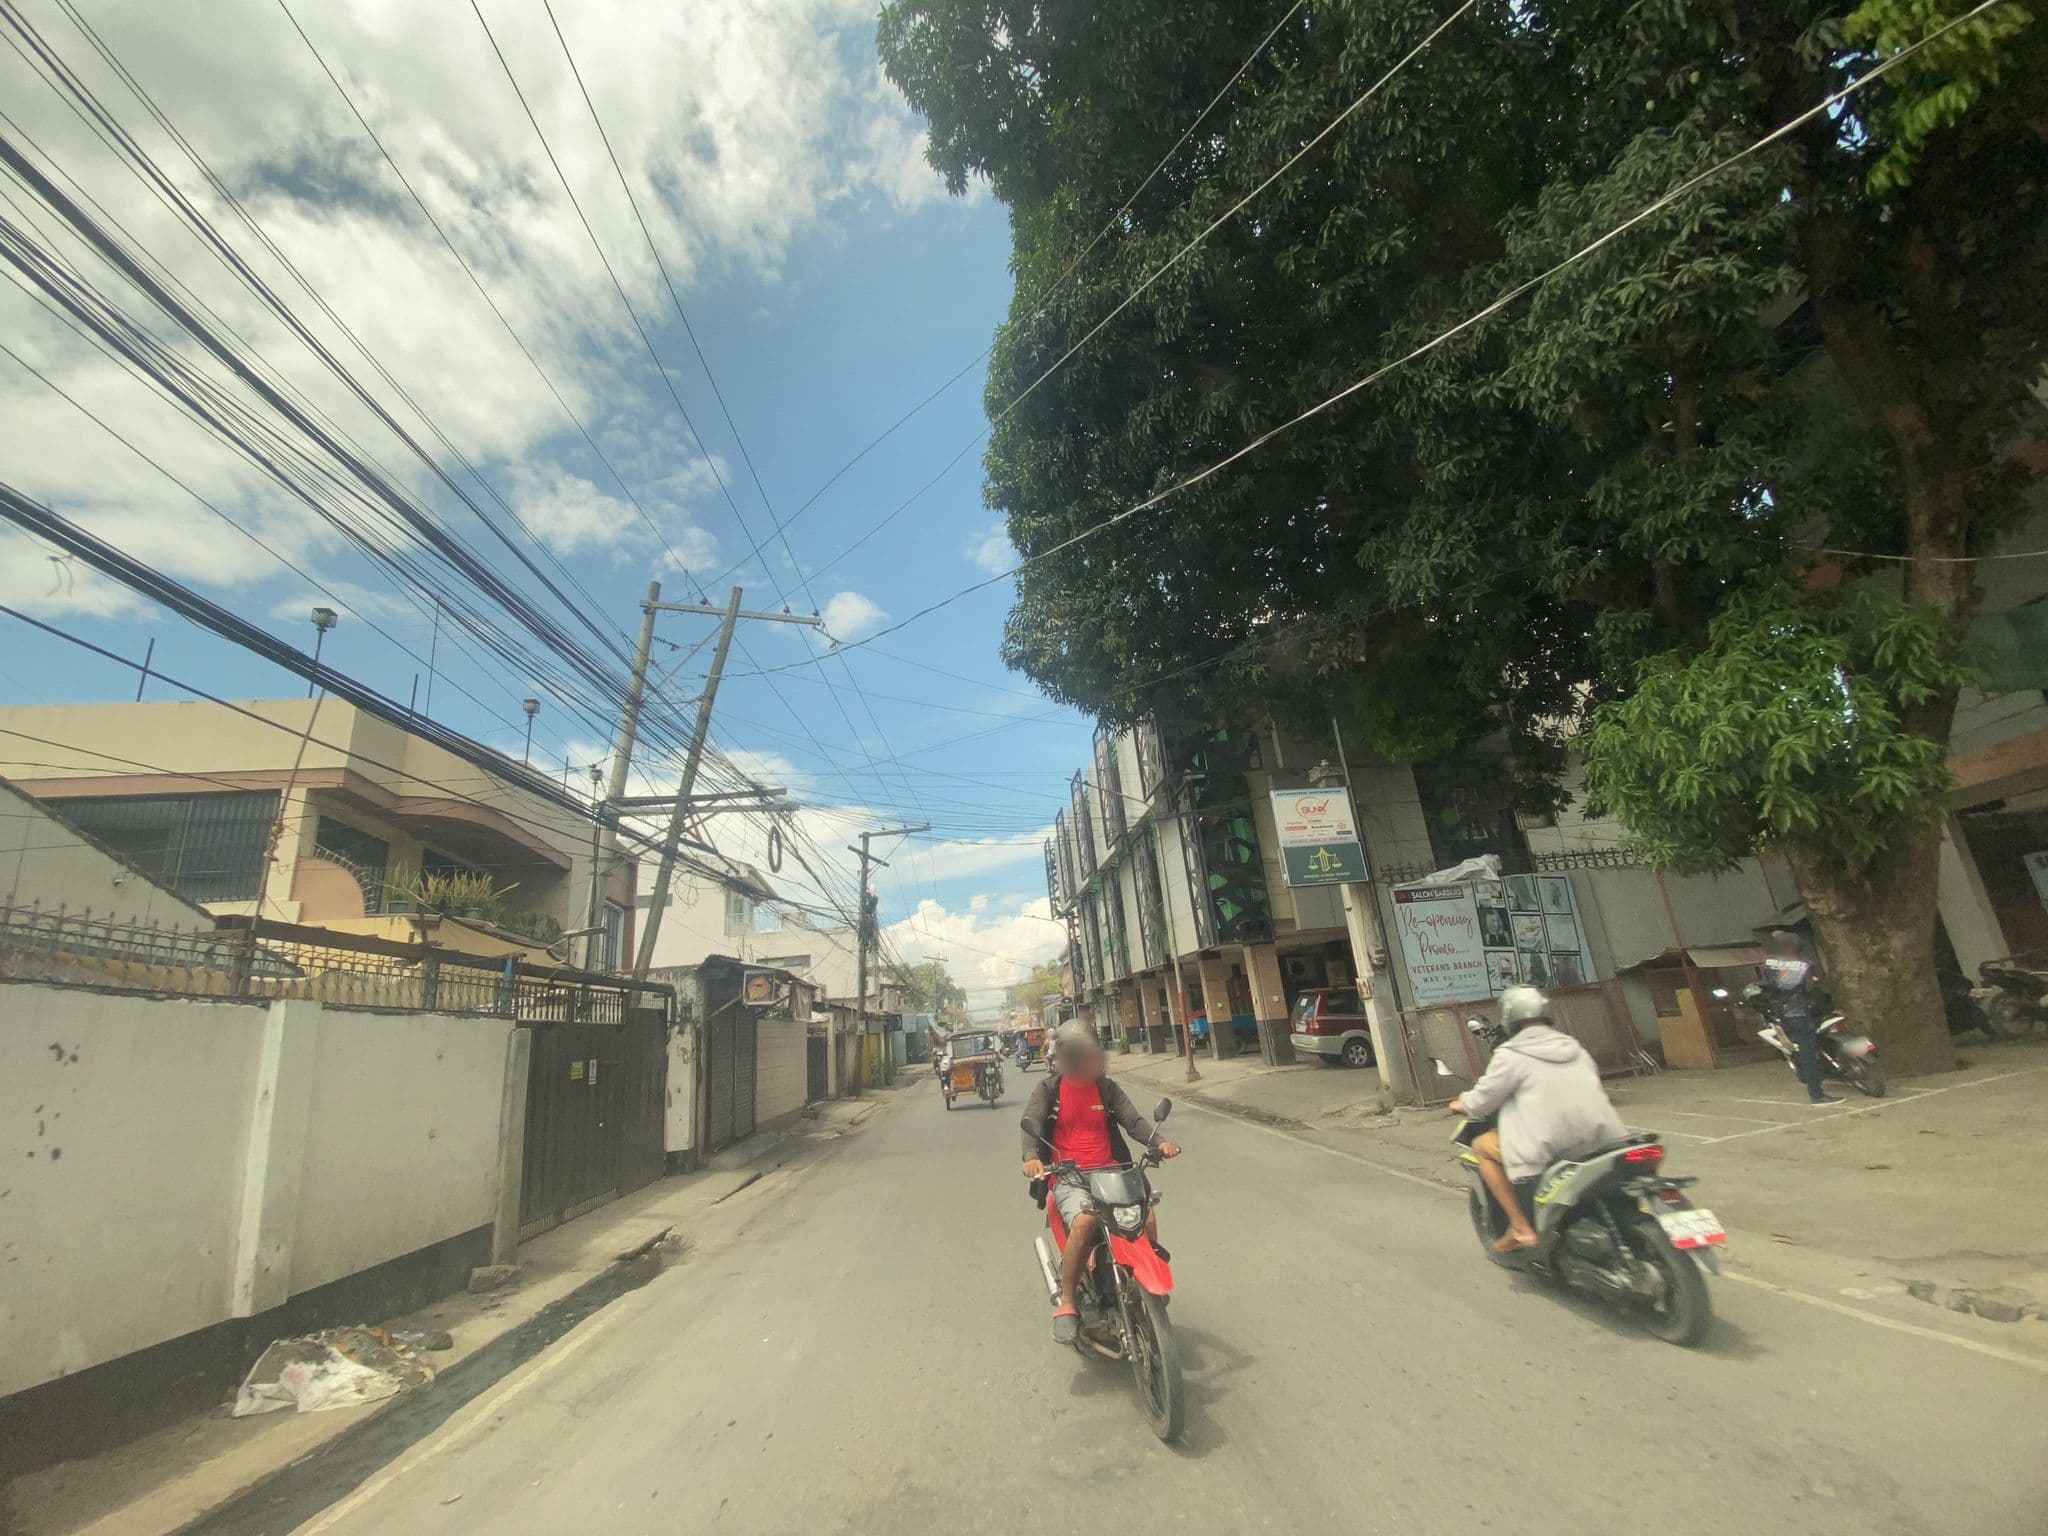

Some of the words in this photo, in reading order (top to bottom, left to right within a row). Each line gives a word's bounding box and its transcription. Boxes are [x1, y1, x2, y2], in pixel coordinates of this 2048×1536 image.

[1410, 889, 1434, 899] SALON
[1399, 904, 1473, 939] Re-opening
[1411, 963, 1450, 974] VETERANS
[1453, 960, 1482, 970] BRANCH
